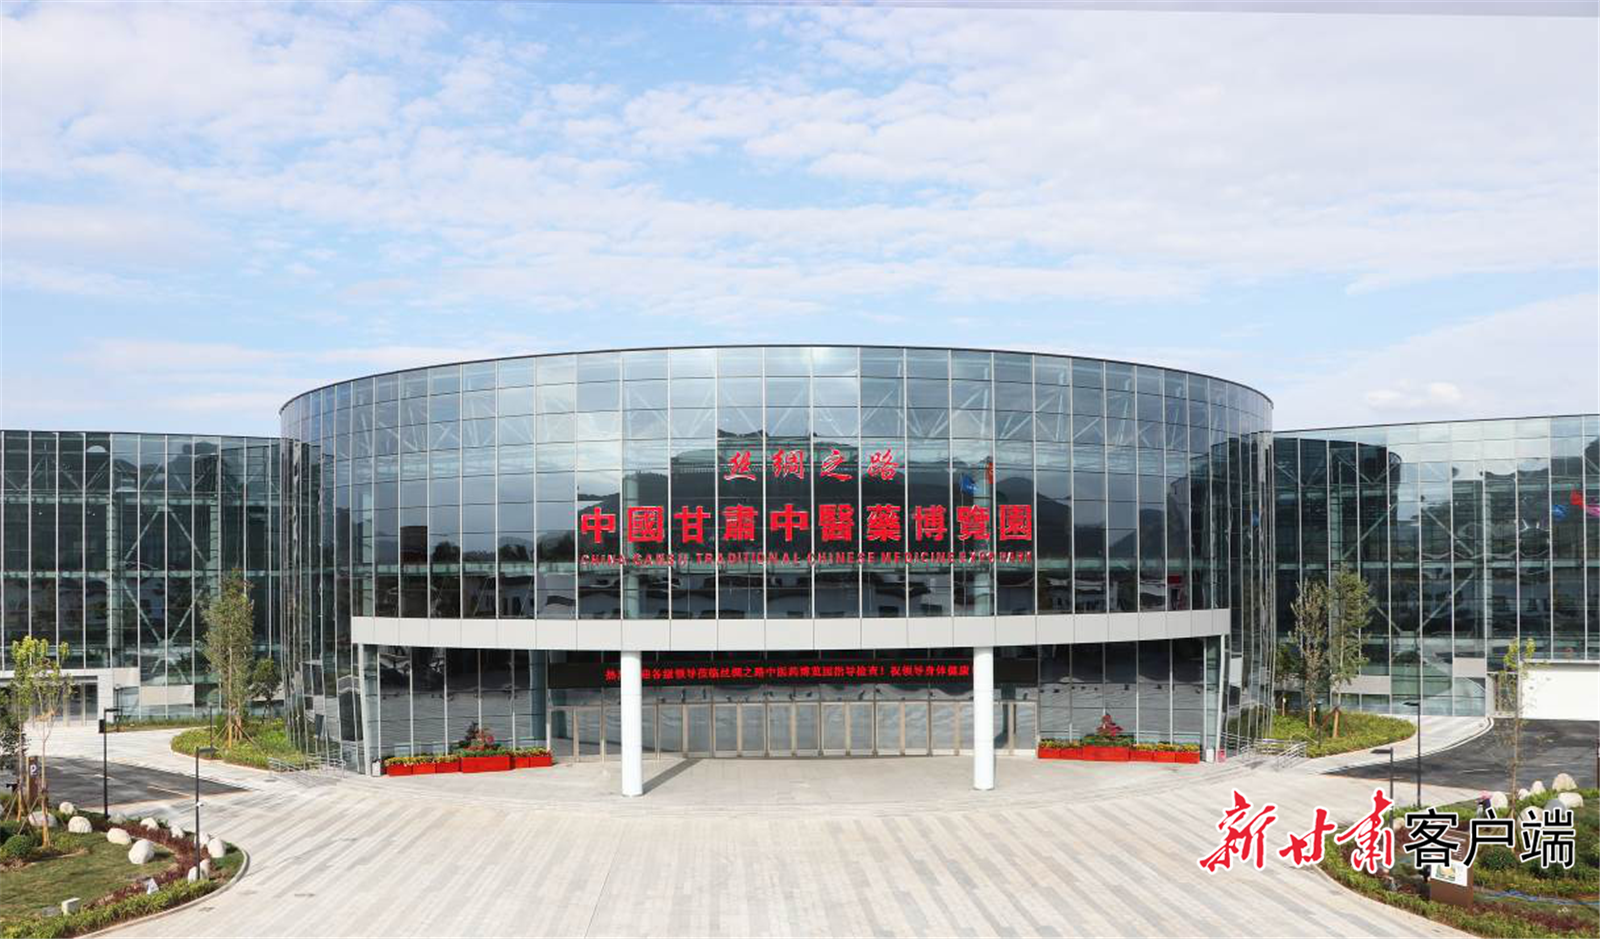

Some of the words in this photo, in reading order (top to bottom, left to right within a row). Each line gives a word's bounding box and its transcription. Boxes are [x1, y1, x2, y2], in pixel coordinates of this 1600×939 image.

[580, 553, 627, 567] CHINA
[632, 552, 688, 567] GANSU
[696, 551, 801, 566] TRADITIONAL
[807, 551, 875, 565] CHINESE
[881, 551, 955, 564] MEDICINE
